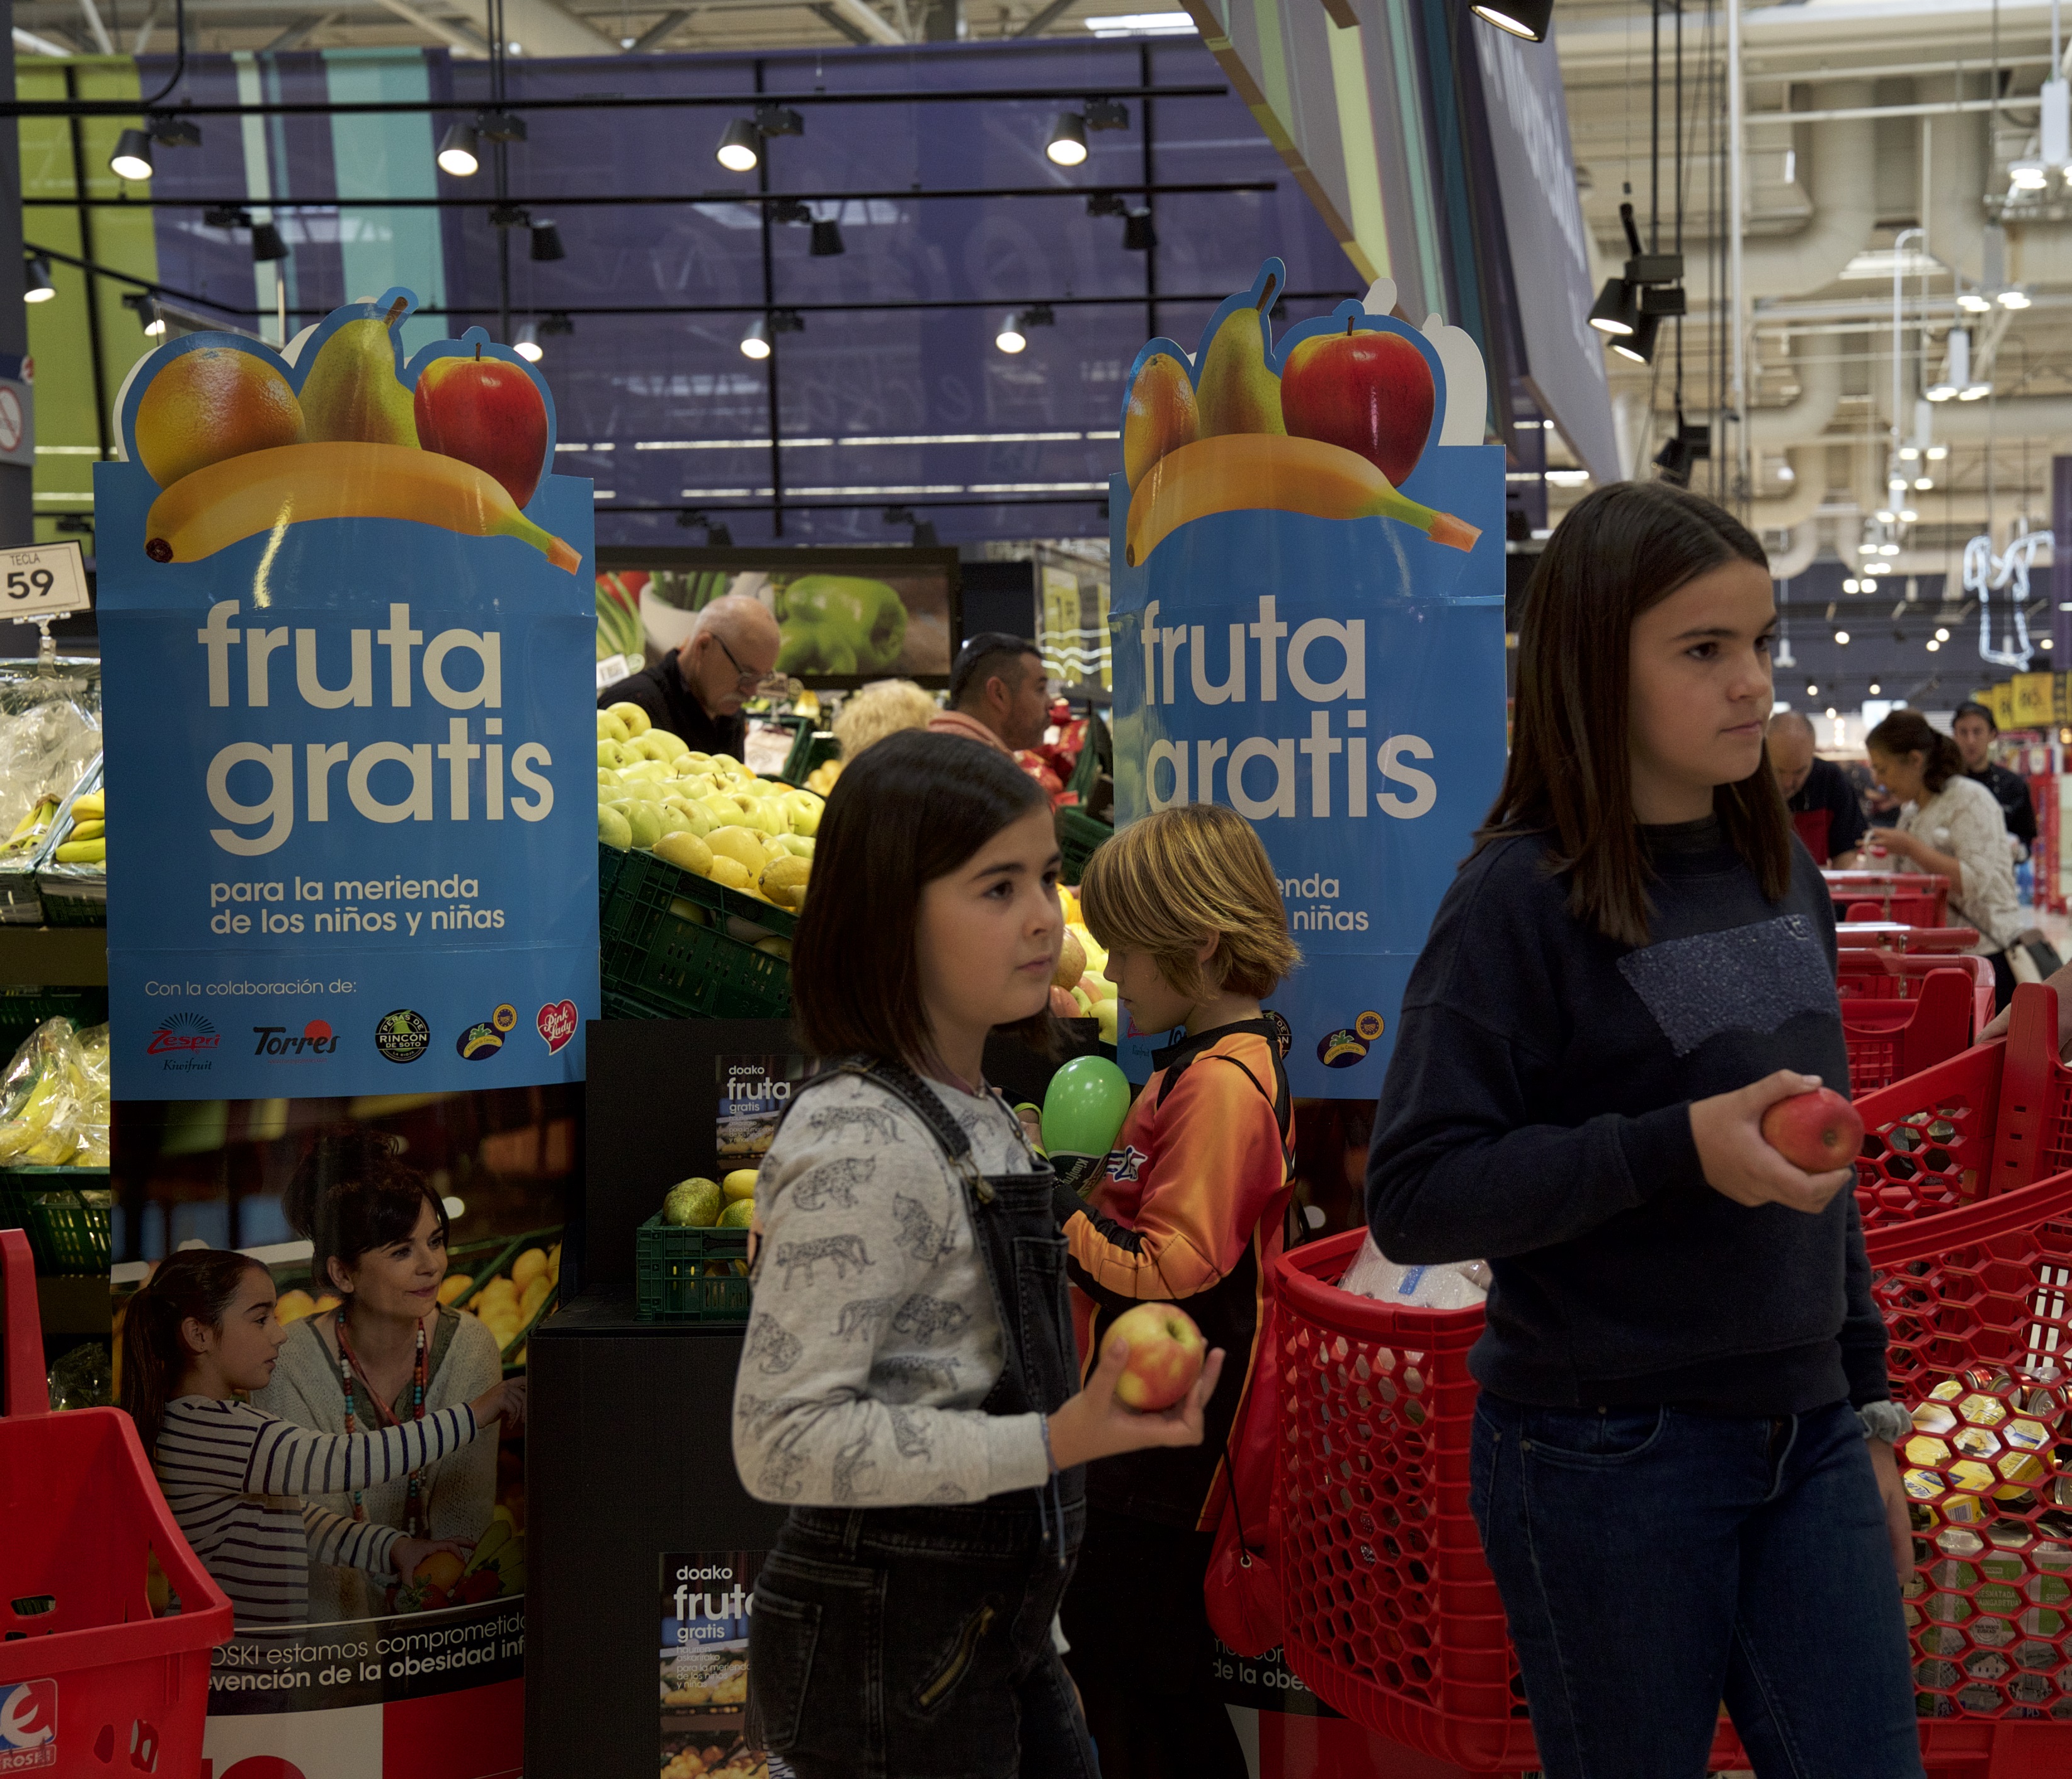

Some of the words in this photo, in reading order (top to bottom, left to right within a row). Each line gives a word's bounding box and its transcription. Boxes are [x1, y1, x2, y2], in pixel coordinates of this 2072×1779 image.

[9, 553, 40, 566] TECLA
[7, 569, 54, 600] 59
[197, 599, 502, 710] fruta
[1141, 594, 1366, 706] fruta
[205, 717, 554, 856] gratis
[210, 880, 285, 907] para
[295, 877, 324, 901] la
[334, 874, 479, 901] merienda
[1276, 873, 1340, 899] enda
[210, 909, 251, 935] de
[261, 909, 305, 935] los
[314, 907, 397, 933] niños
[406, 911, 423, 936] y
[431, 904, 505, 930] niñas
[1293, 904, 1369, 931] niñas
[144, 979, 184, 997] Con
[186, 979, 202, 996] la
[205, 978, 324, 996] colaboración
[329, 977, 357, 994] de:
[382, 1014, 411, 1032] PERAS
[413, 1018, 424, 1031] DE
[544, 1006, 568, 1032] Pink
[1277, 1020, 1287, 1033] DE
[253, 1026, 342, 1055] Torres
[380, 1032, 427, 1043] RINCÓN
[548, 1020, 574, 1041] Lady
[147, 1030, 221, 1055] Zespri
[162, 1058, 213, 1073] Kiwifruit
[728, 1064, 765, 1075] doako
[727, 1077, 791, 1100] fruta
[729, 1102, 760, 1114] gratis
[1062, 1157, 1090, 1185] Kiwifru
[676, 1564, 733, 1581] doako
[676, 1623, 726, 1644] gratis
[210, 1645, 259, 1667] OSKI
[266, 1640, 368, 1666] estamos
[389, 1642, 496, 1678] obesidad
[501, 1637, 525, 1659] inf
[676, 1645, 711, 1654] haurren
[676, 1653, 720, 1662] askarirako
[208, 1669, 310, 1692] vención
[318, 1665, 351, 1686] de
[359, 1661, 382, 1682] la
[676, 1665, 698, 1674] para
[700, 1663, 708, 1671] la
[676, 1672, 689, 1681] de
[691, 1671, 703, 1680] los
[705, 1671, 728, 1680] niños
[1239, 1662, 1256, 1685] la
[1262, 1668, 1312, 1692] obe
[676, 1681, 682, 1690] y
[684, 1680, 708, 1688] niñas
[0, 1749, 52, 1771] ROSKI
